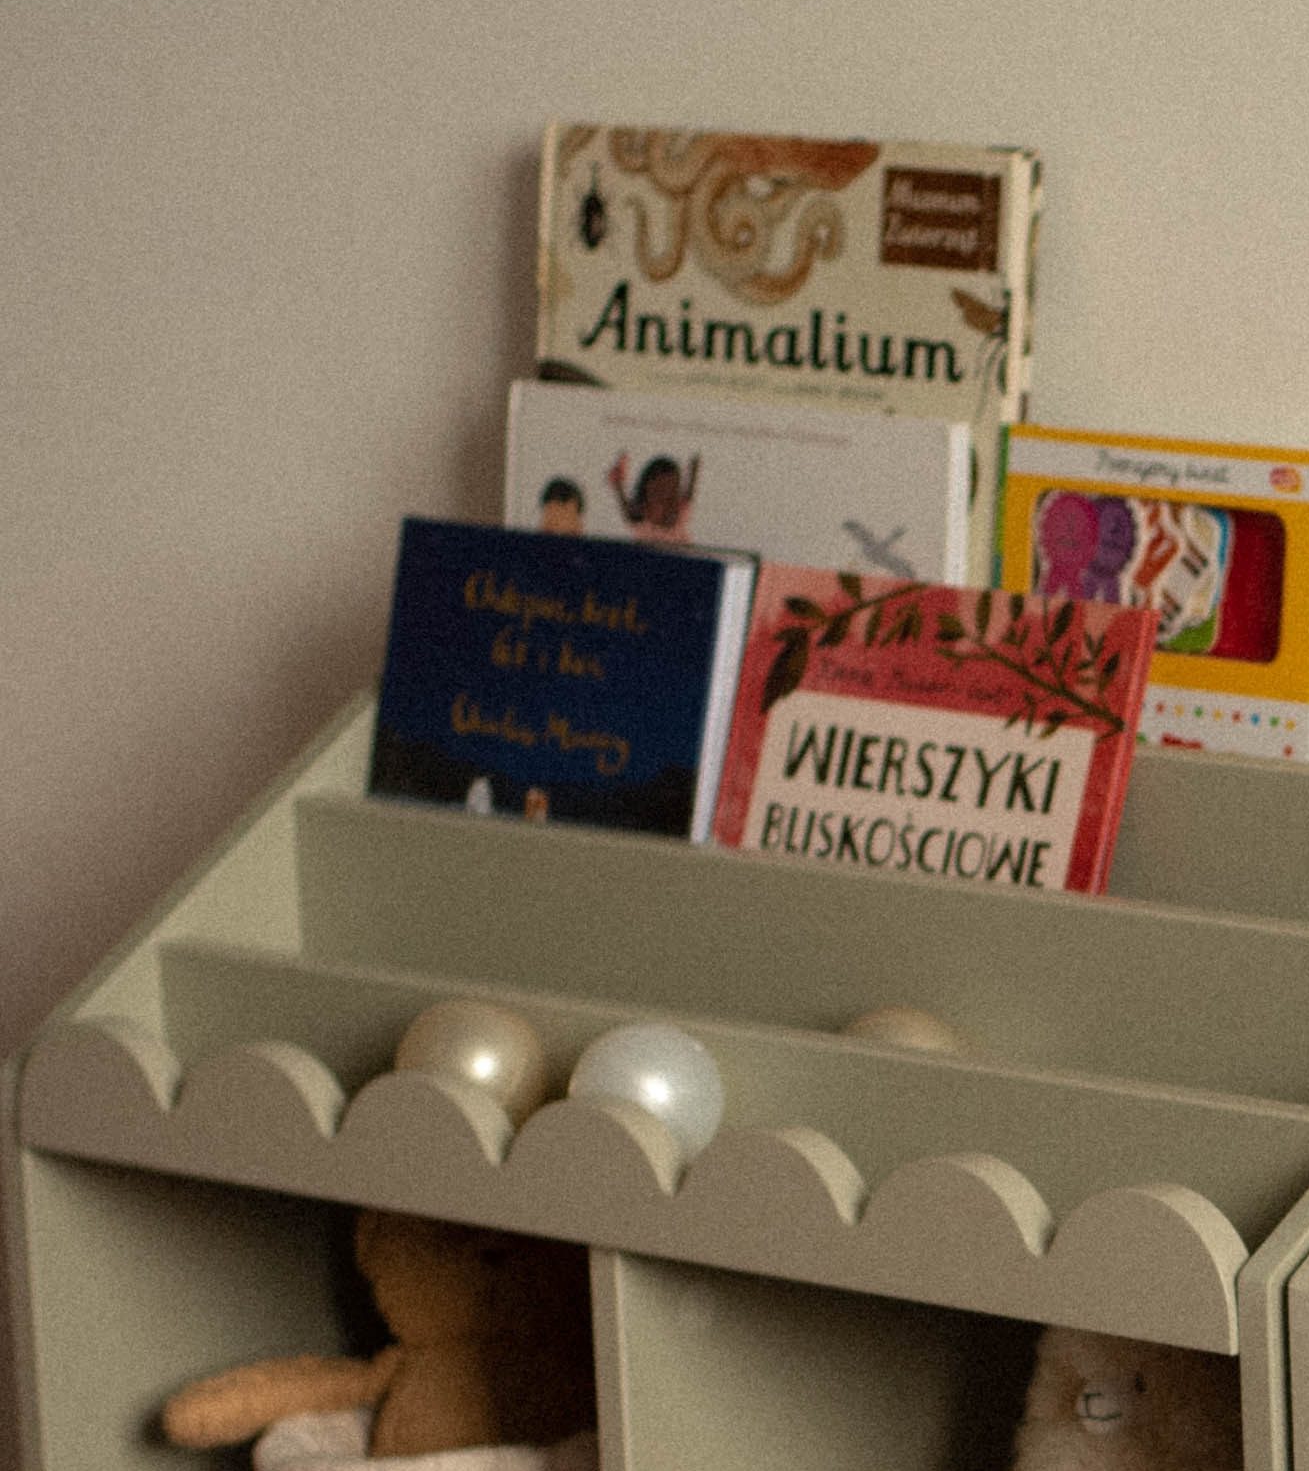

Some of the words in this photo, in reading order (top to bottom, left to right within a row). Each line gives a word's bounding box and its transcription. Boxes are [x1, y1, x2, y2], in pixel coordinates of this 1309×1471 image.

[579, 279, 963, 384] Animalium
[783, 720, 1061, 815] WIERSZYKI
[760, 802, 1052, 888] BLISKOŚCIOWE
